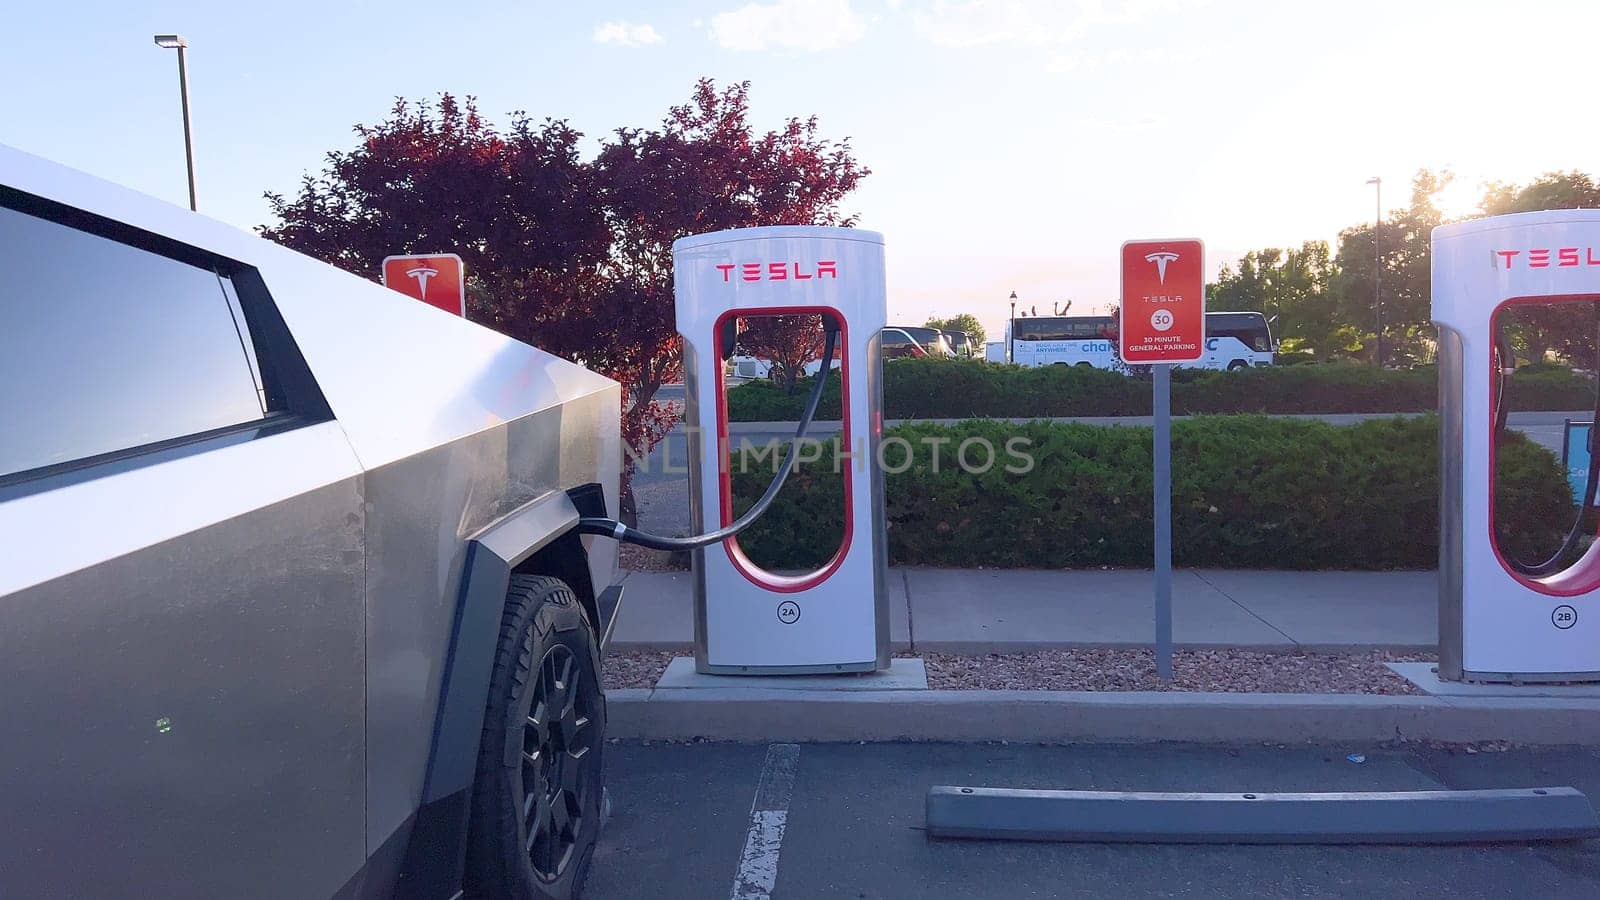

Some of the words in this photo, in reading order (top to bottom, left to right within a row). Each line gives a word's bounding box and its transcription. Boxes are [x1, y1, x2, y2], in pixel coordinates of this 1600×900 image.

[716, 261, 836, 282] TESLA
[1143, 295, 1183, 303] TESLA
[1154, 315, 1171, 325] 30
[782, 608, 795, 616] 2A
[1558, 613, 1572, 621] 2B
